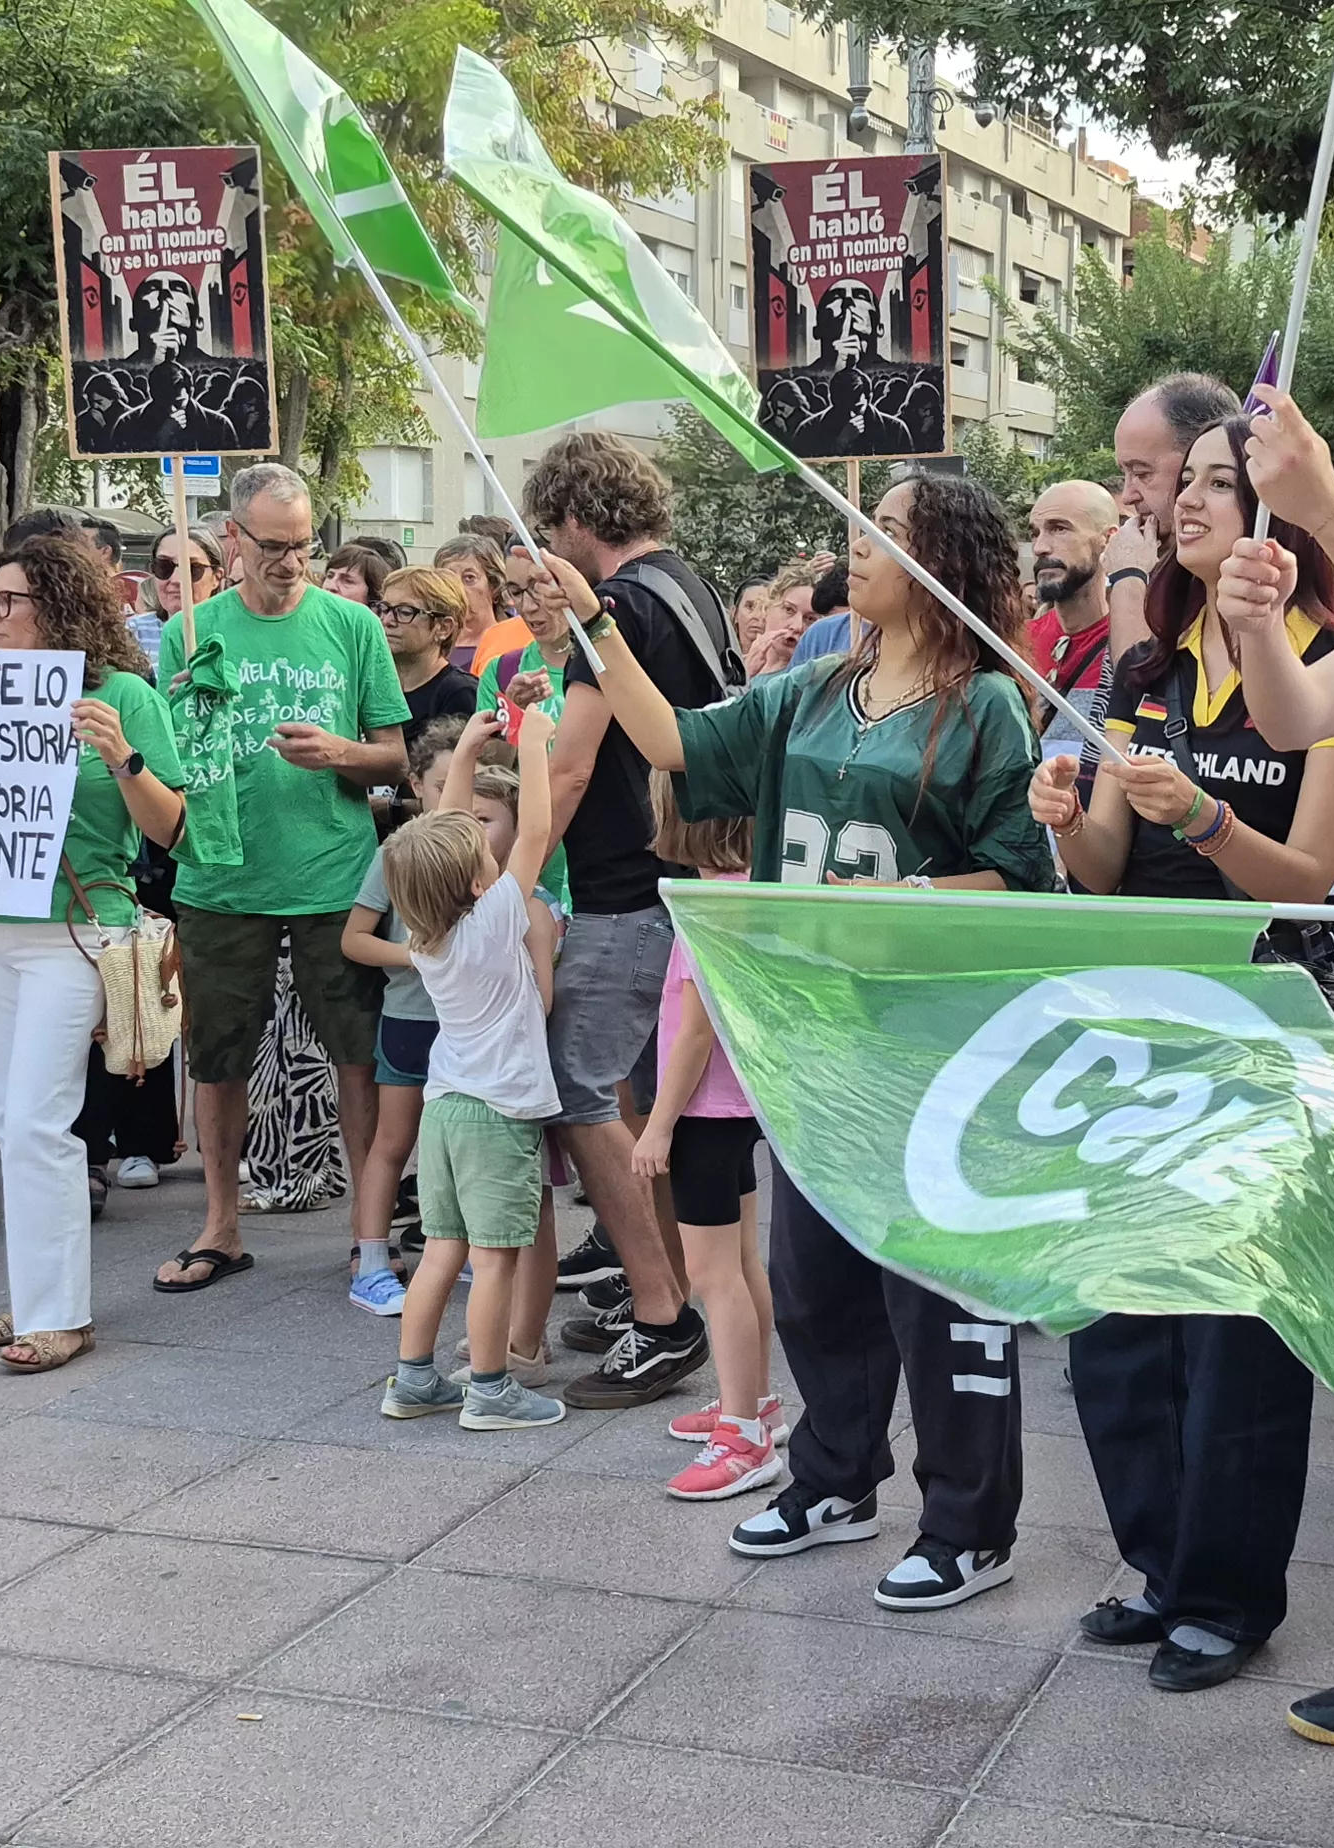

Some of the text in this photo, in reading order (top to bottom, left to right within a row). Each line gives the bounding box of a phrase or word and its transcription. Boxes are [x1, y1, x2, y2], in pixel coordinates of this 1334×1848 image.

[123, 152, 195, 203] ÉL
[812, 162, 880, 214] ÉL
[121, 201, 201, 230] habló
[809, 209, 885, 240] habló
[102, 227, 225, 252] en mi nombre
[789, 233, 907, 263] en mi nombre
[112, 249, 221, 274] y se lo llevaron
[797, 255, 903, 284] y se lo llevaron
[35, 663, 68, 708] LO
